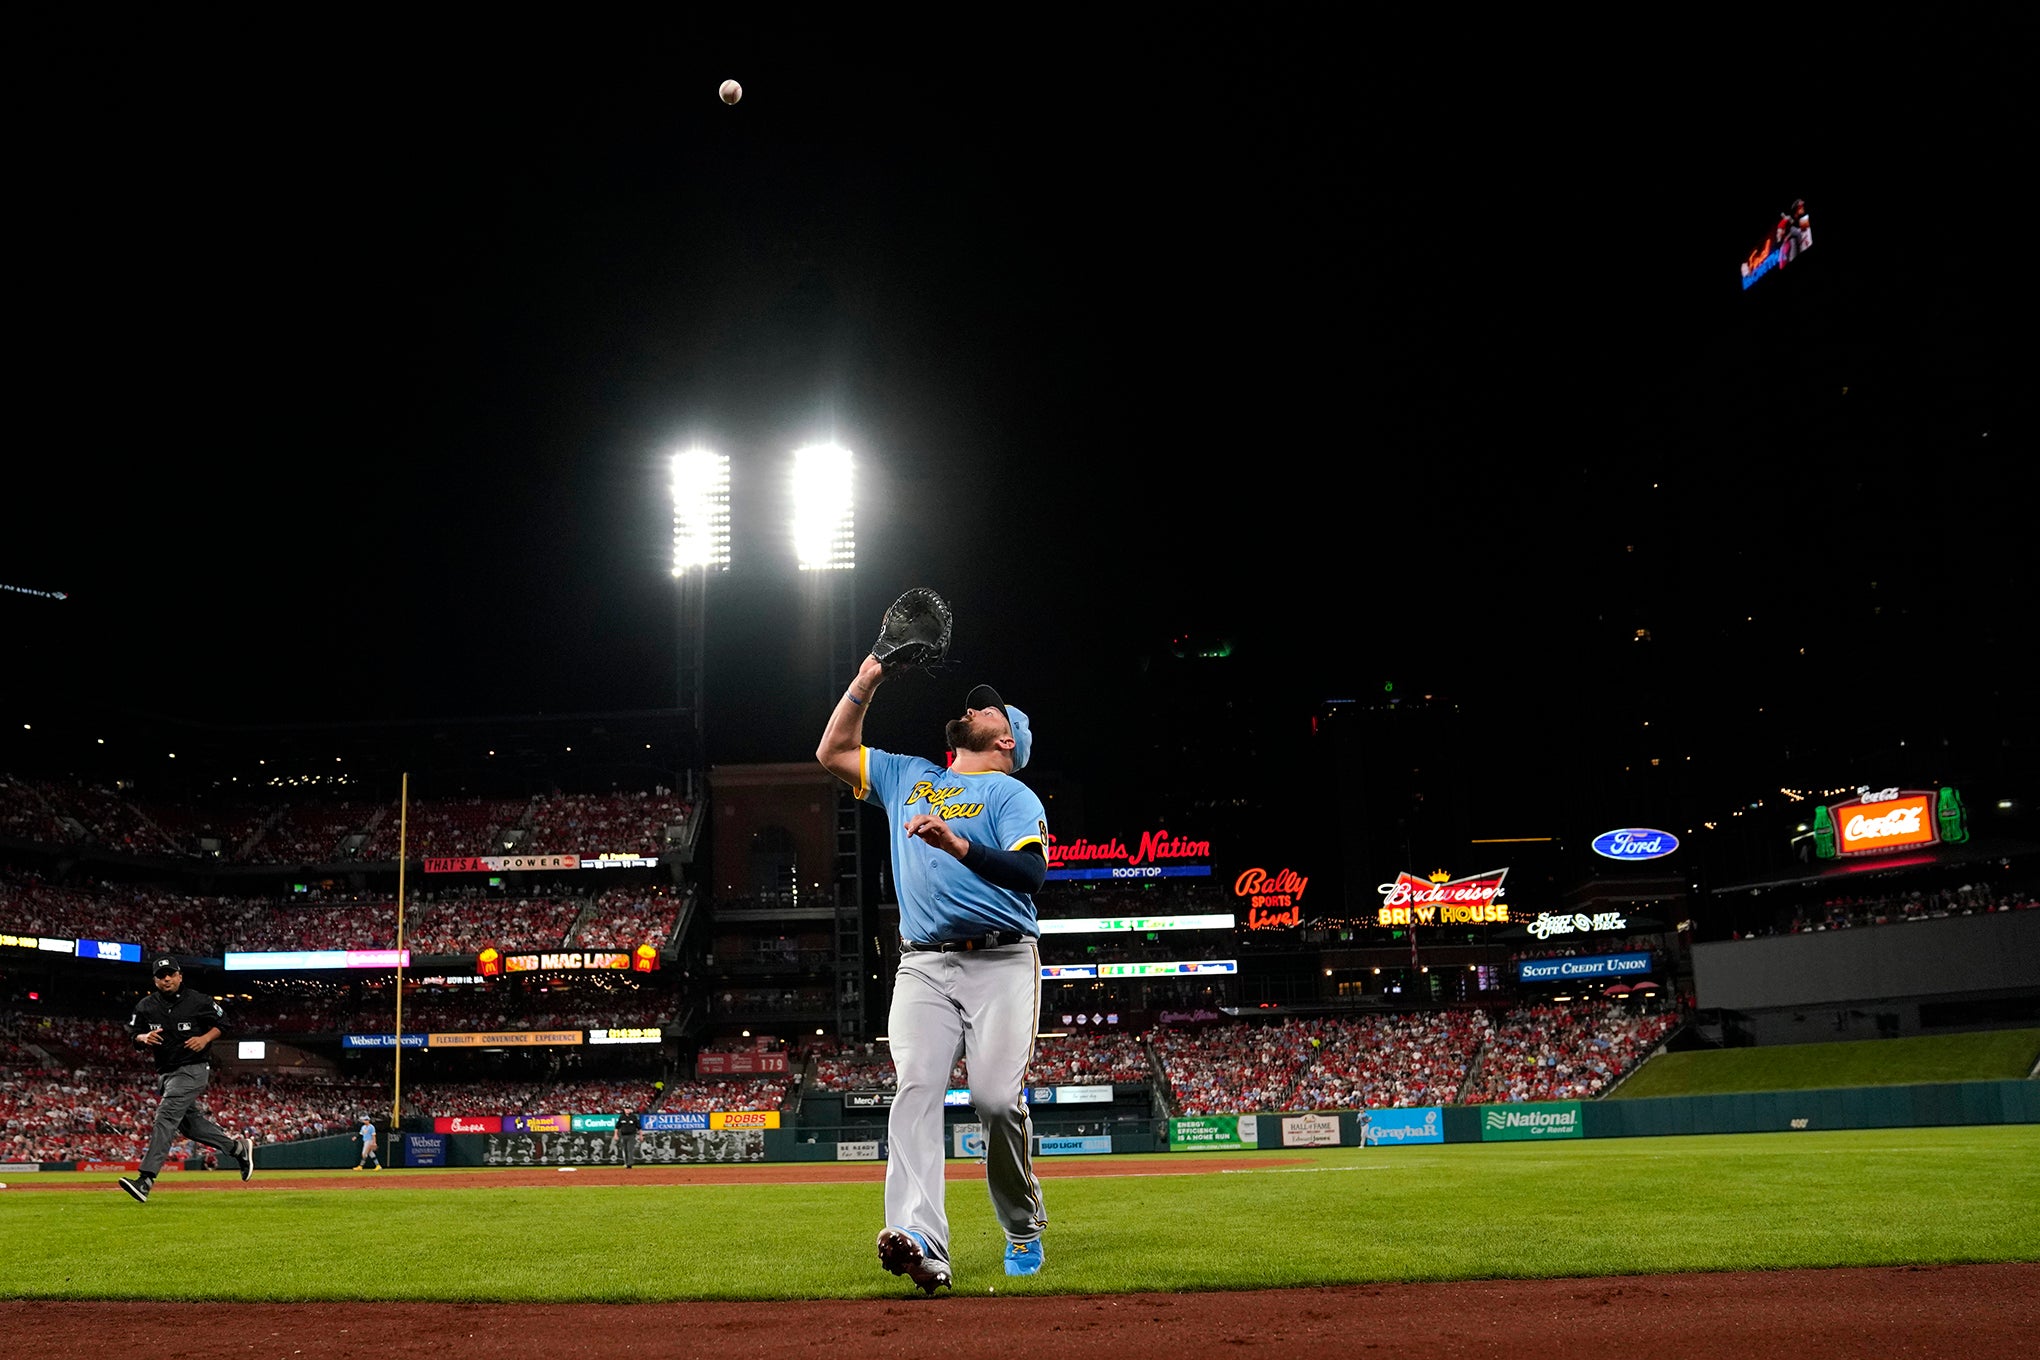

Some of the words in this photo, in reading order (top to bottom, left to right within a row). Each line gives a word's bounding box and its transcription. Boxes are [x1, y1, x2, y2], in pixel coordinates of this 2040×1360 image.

[905, 781, 966, 805] Brew
[930, 800, 984, 821] Crew
[1845, 806, 1924, 841] Coca-Cola
[1129, 830, 1210, 865] Nation
[1610, 832, 1662, 855] Ford
[427, 859, 466, 870] THAT'S
[471, 859, 478, 870] A
[1112, 867, 1162, 878] ROOFTOP
[1235, 868, 1309, 901] Bally
[1377, 883, 1506, 905] Budweiser
[1252, 895, 1292, 907] SPORTS
[1250, 906, 1299, 929] Live!
[1441, 904, 1510, 923] HOUSE
[1593, 912, 1620, 922] MVP
[1593, 919, 1627, 931] DECK
[541, 954, 582, 969] MAC
[1522, 965, 1559, 977] SCOTT
[1561, 962, 1604, 974] CREDIT
[1607, 960, 1647, 971] UNION
[350, 1035, 380, 1046] Webster
[383, 1034, 424, 1046] Uniersity
[436, 1036, 475, 1044] FLEXIBILITY
[481, 1034, 528, 1043] CONVENIENCE
[534, 1033, 577, 1042] EXPERIENCE
[761, 1059, 783, 1070] 179
[854, 1097, 875, 1106] Mercy
[527, 1117, 555, 1127] planet
[659, 1114, 706, 1123] SITEMAN
[725, 1114, 767, 1123] DOBBS
[1506, 1110, 1576, 1127] National
[954, 1124, 982, 1134] CarShi
[1531, 1126, 1545, 1134] Car
[1547, 1125, 1574, 1133] Rental
[410, 1136, 441, 1147] Webster
